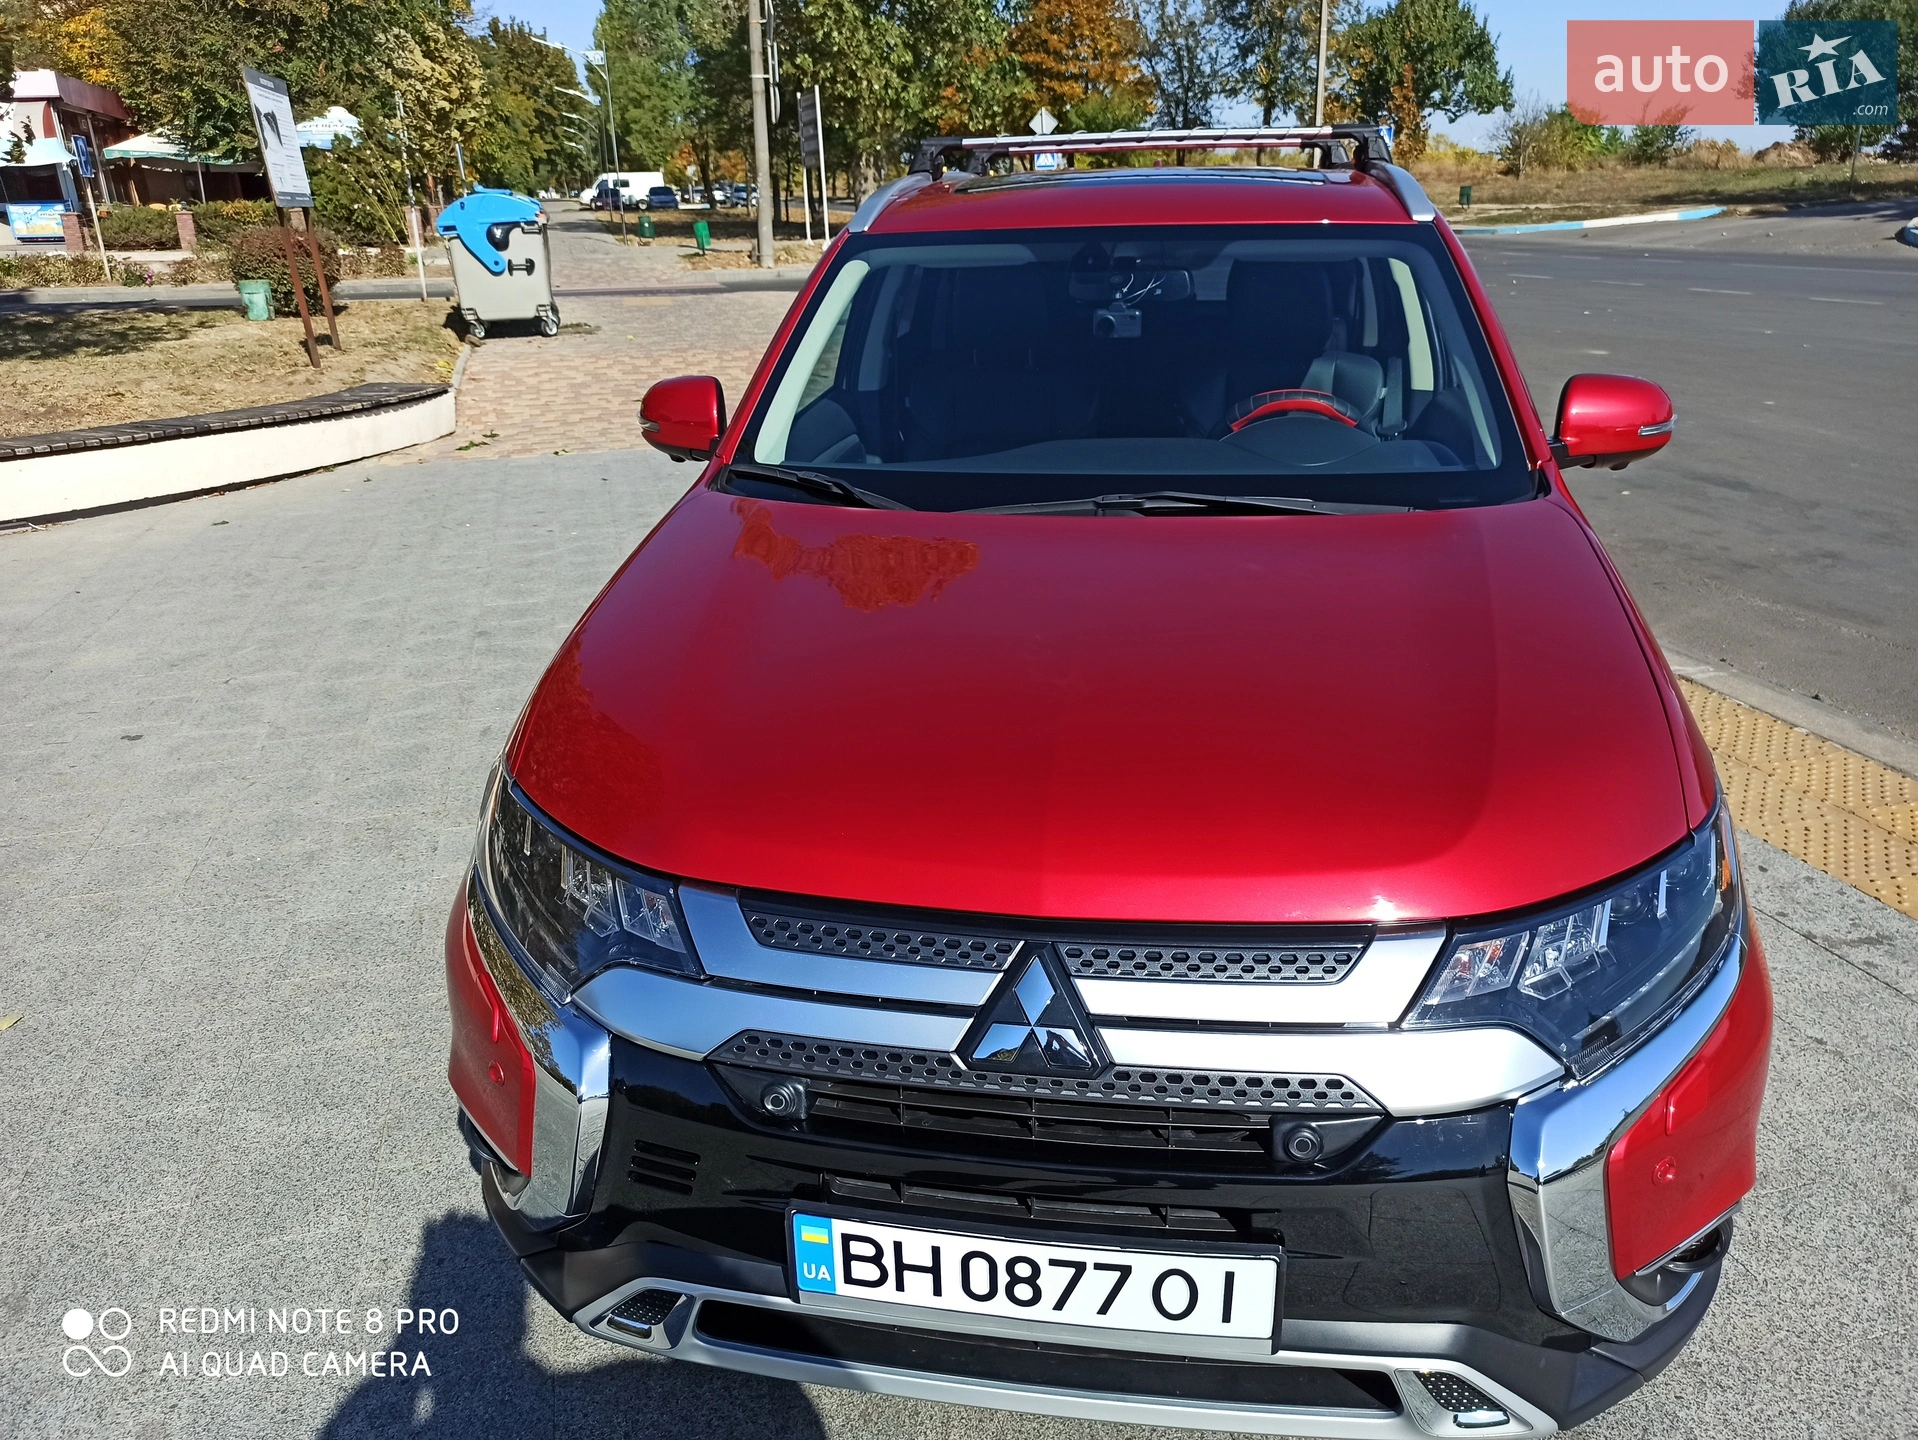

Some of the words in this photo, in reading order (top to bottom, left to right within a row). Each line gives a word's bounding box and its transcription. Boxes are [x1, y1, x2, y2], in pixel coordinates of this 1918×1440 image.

[803, 1262, 832, 1282] UA
[841, 1233, 942, 1298] BH
[961, 1251, 1132, 1316] 0877
